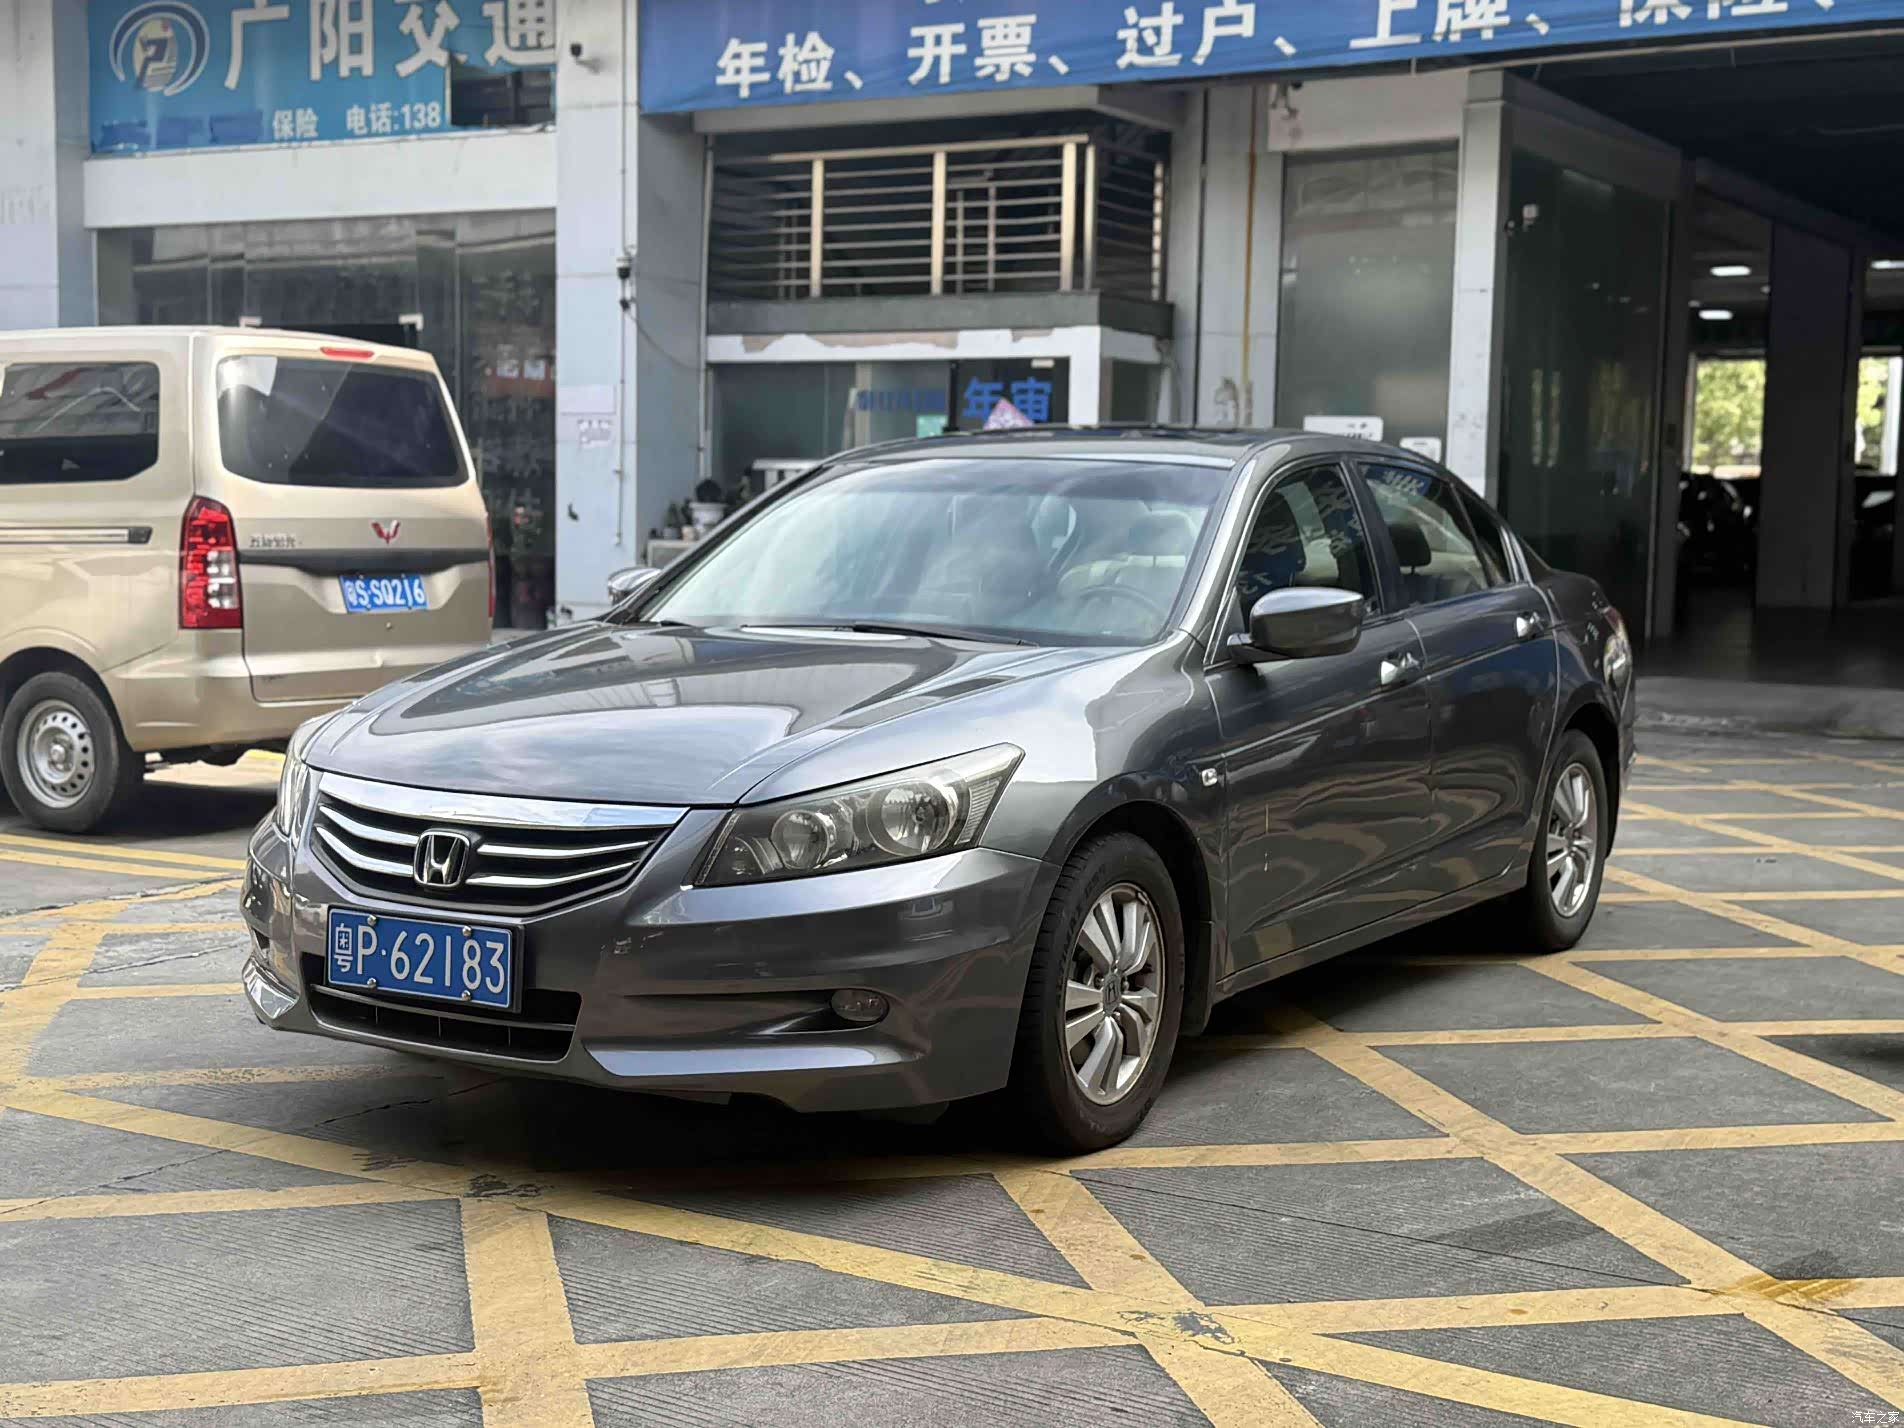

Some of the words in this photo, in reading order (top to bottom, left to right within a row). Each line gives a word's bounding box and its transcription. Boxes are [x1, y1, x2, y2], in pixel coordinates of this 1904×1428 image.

[225, 0, 557, 90] 广阳交通
[272, 107, 318, 139] 保险
[346, 102, 441, 135] 电话:138
[333, 922, 506, 994] 粤P·62183
